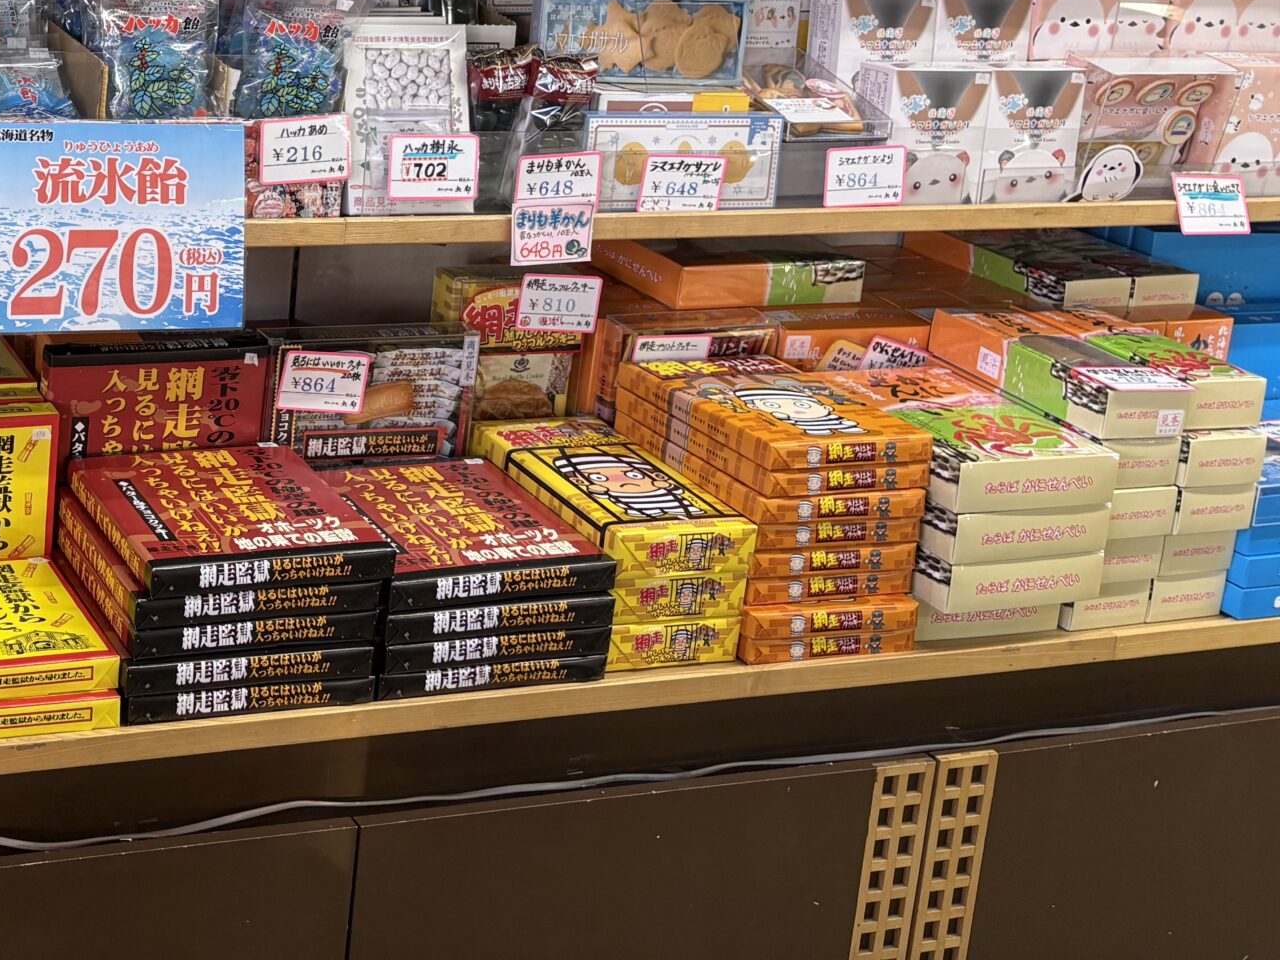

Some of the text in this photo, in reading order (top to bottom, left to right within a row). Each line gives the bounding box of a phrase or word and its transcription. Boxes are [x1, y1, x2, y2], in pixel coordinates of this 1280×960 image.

[547, 32, 629, 53] シマエナガサブレ
[280, 124, 328, 138] ハッカあめ
[64, 141, 160, 155] りゅうひょうあめ
[272, 145, 323, 163] ¥216
[403, 139, 464, 155] ハッカ樹氷
[405, 162, 447, 178] ¥702
[526, 158, 586, 174] まりも羊かん
[33, 155, 187, 206] 流氷飴
[526, 180, 573, 197] ¥648
[651, 181, 698, 196] ¥648
[836, 173, 879, 187] ¥864
[516, 209, 590, 229] まりも羊かん
[178, 247, 223, 266] (税込)
[520, 241, 562, 259] 648円
[9, 227, 218, 318] 270 円
[529, 298, 576, 313] ¥810
[291, 377, 336, 392] ¥864
[1160, 413, 1181, 427] 見本
[828, 442, 855, 460] 網走
[828, 470, 854, 487] 網走
[985, 476, 1093, 494] たらば かにせんべい
[820, 498, 847, 514] 網走
[256, 516, 341, 534] オホーツク
[234, 527, 359, 551] 地の果ての監獄
[479, 528, 559, 547] オホーツク
[982, 524, 1086, 545] たらば かにせんべい
[462, 540, 580, 562] 地の果ての監獄
[199, 553, 344, 588] 網走監獄 見るにはいいが
[435, 572, 502, 600] 網走監獄
[976, 574, 1080, 595] たらば かにせんべい
[184, 585, 329, 618] 網走監獄 見るにはいいが
[182, 616, 327, 650] 網走監獄 見るにはいいが
[176, 657, 248, 686] 網走監獄
[176, 688, 248, 715] 網走監獄
